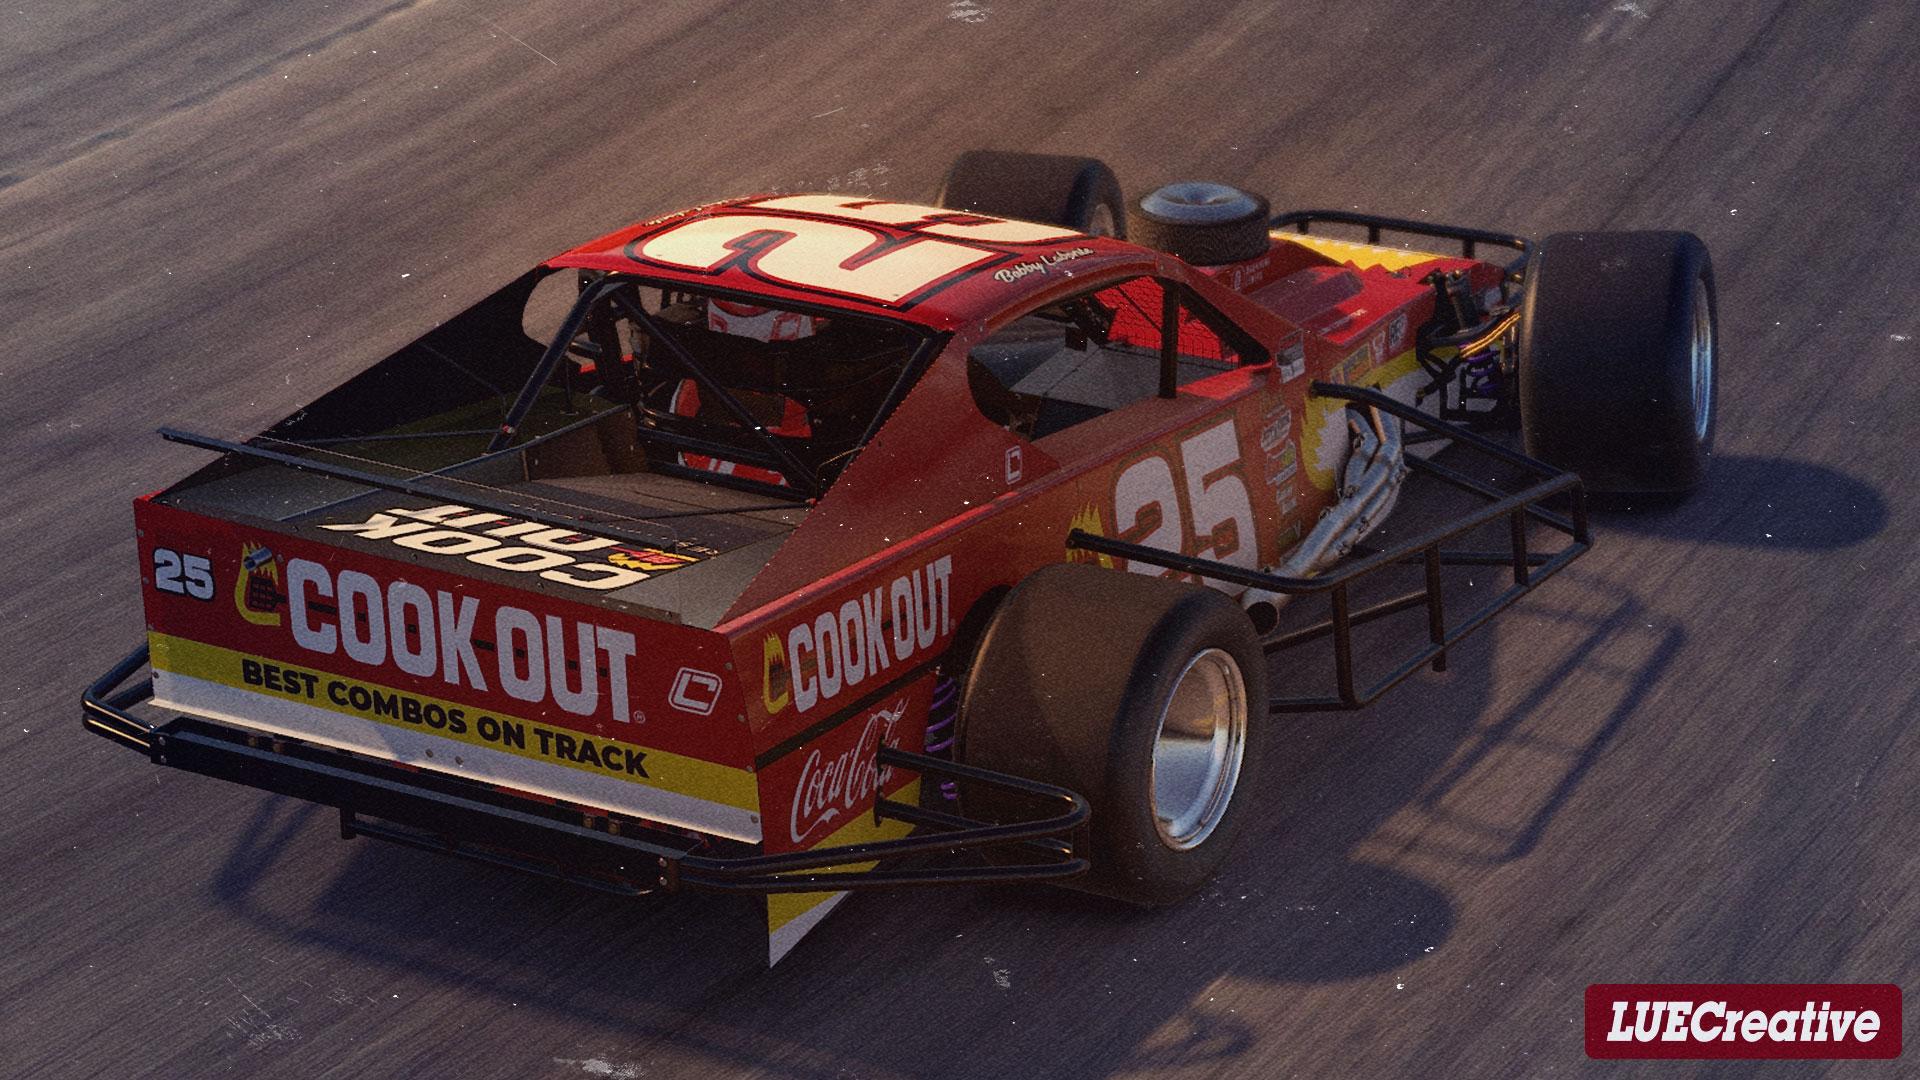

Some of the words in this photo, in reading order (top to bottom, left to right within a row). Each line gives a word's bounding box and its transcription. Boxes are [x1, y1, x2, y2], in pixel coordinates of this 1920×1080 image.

[636, 194, 1088, 304] 25
[994, 262, 1046, 283] Bobby
[317, 513, 652, 591] COOK
[385, 503, 624, 552] OUT
[1115, 418, 1260, 598] 25
[153, 547, 215, 601] 25
[286, 558, 488, 692] COOK
[788, 586, 891, 714] COOK
[890, 554, 952, 662] OUT
[241, 658, 319, 700] BEST
[328, 678, 469, 735] COMBOS
[476, 715, 526, 749] ON
[532, 727, 650, 779] TRACK
